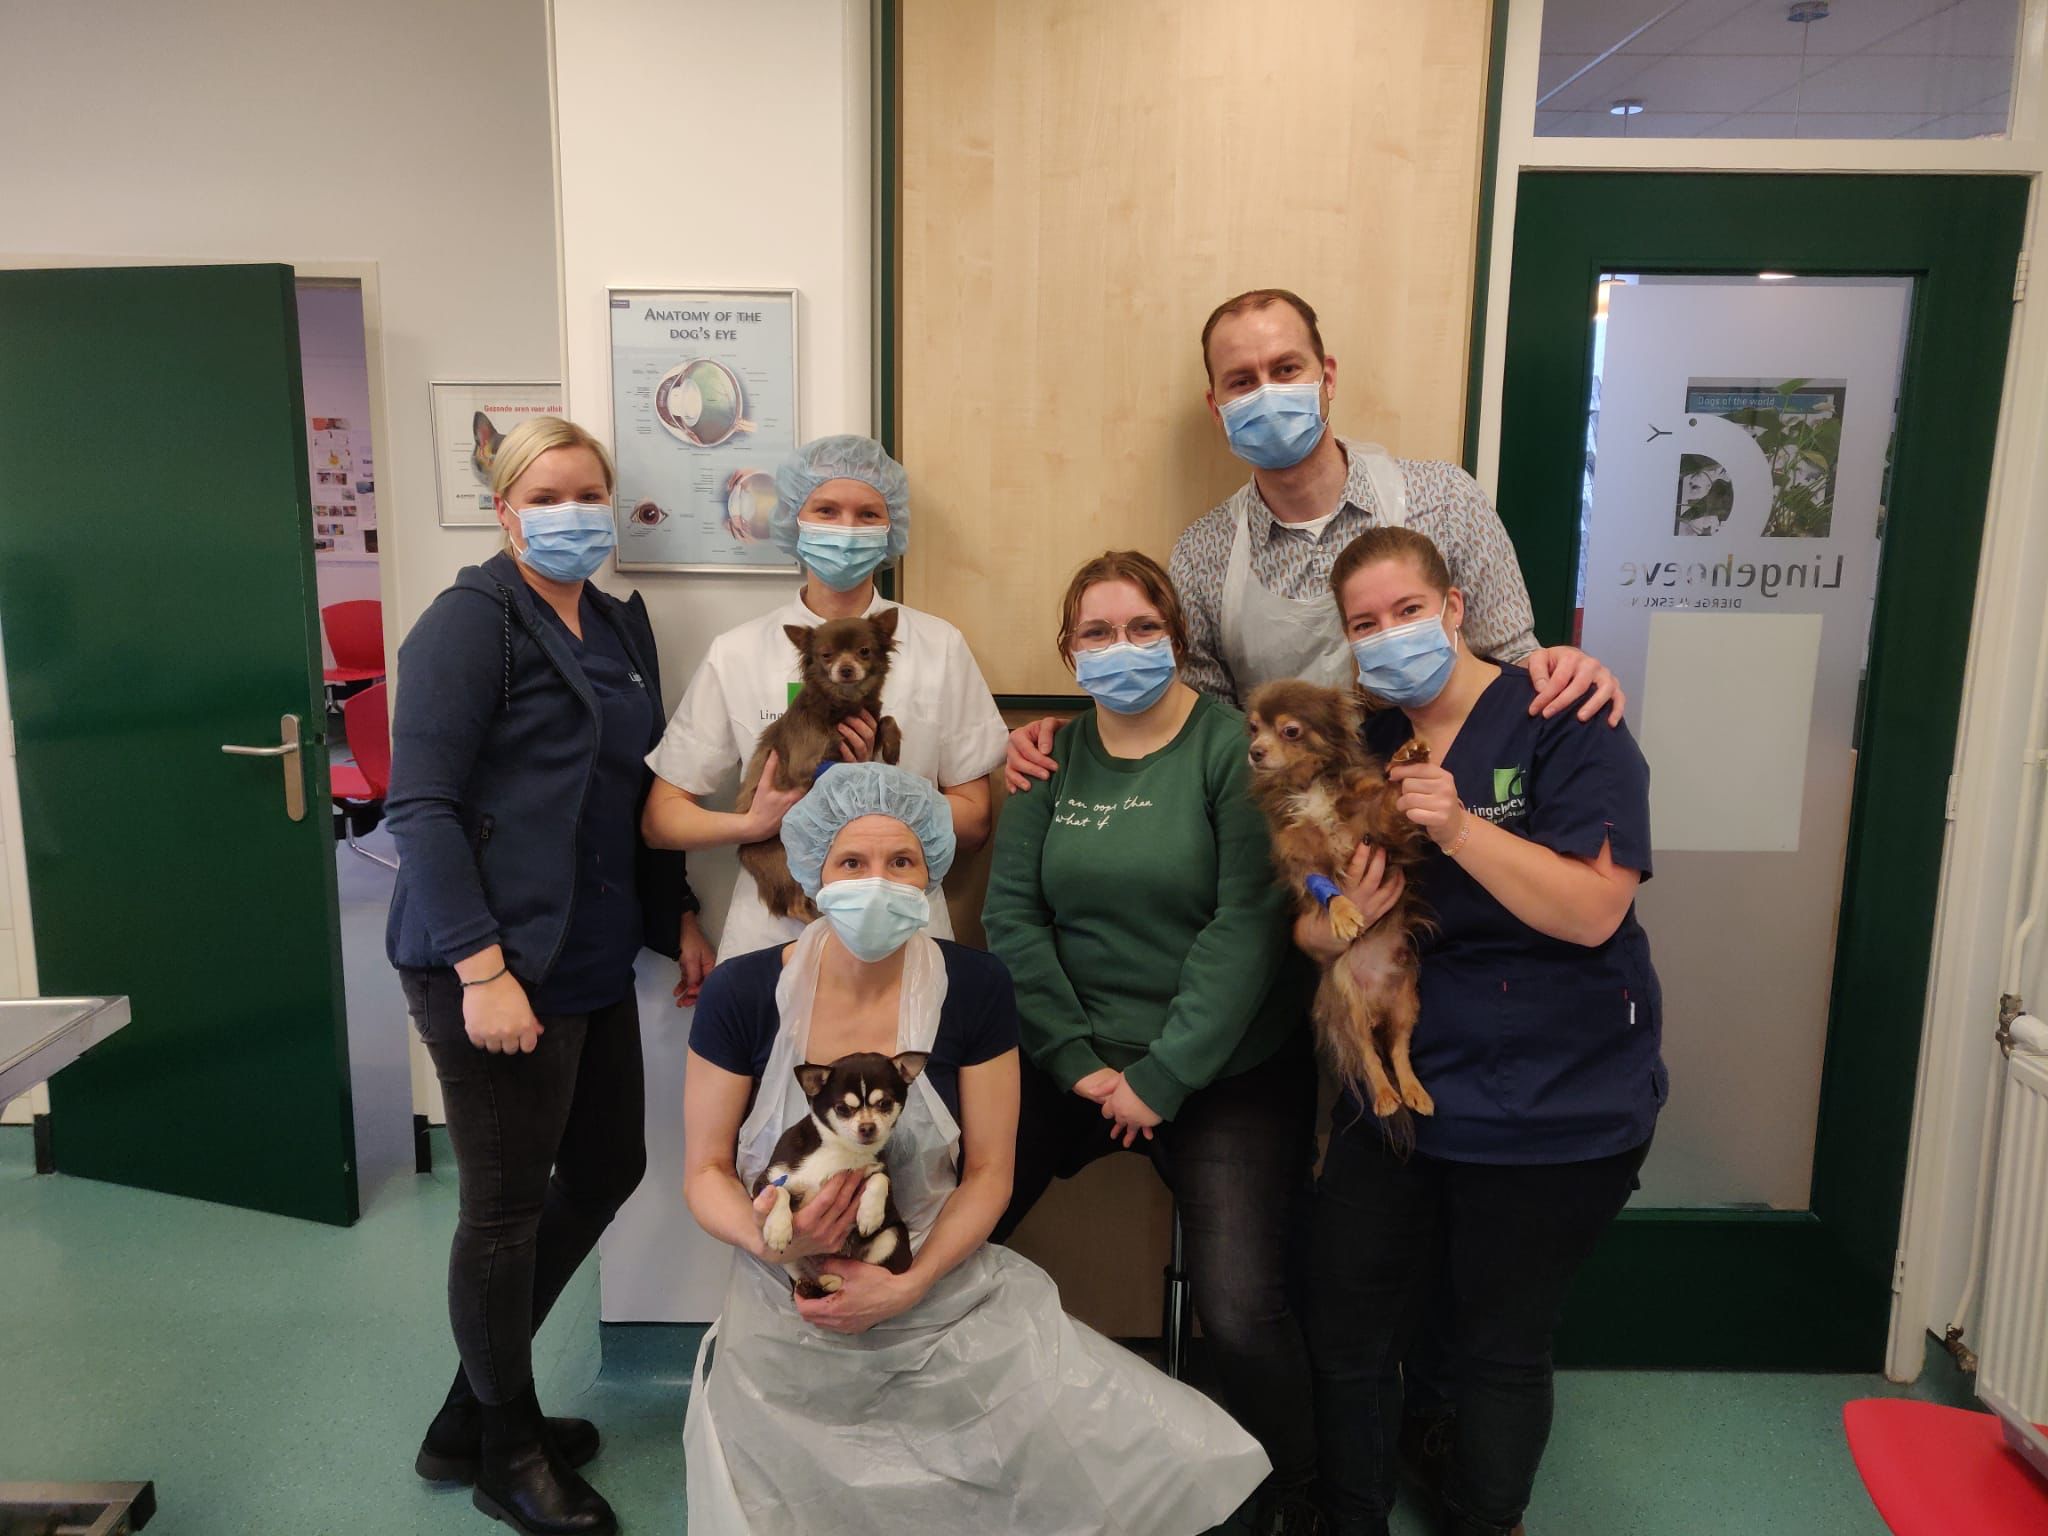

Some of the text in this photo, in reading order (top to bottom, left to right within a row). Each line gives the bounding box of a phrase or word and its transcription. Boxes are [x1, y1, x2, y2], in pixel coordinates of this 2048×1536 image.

[644, 308, 762, 322] ANATOMY OF THE
[670, 327, 737, 340] DOG'S EYE
[1698, 396, 1775, 407] Dogs of the world
